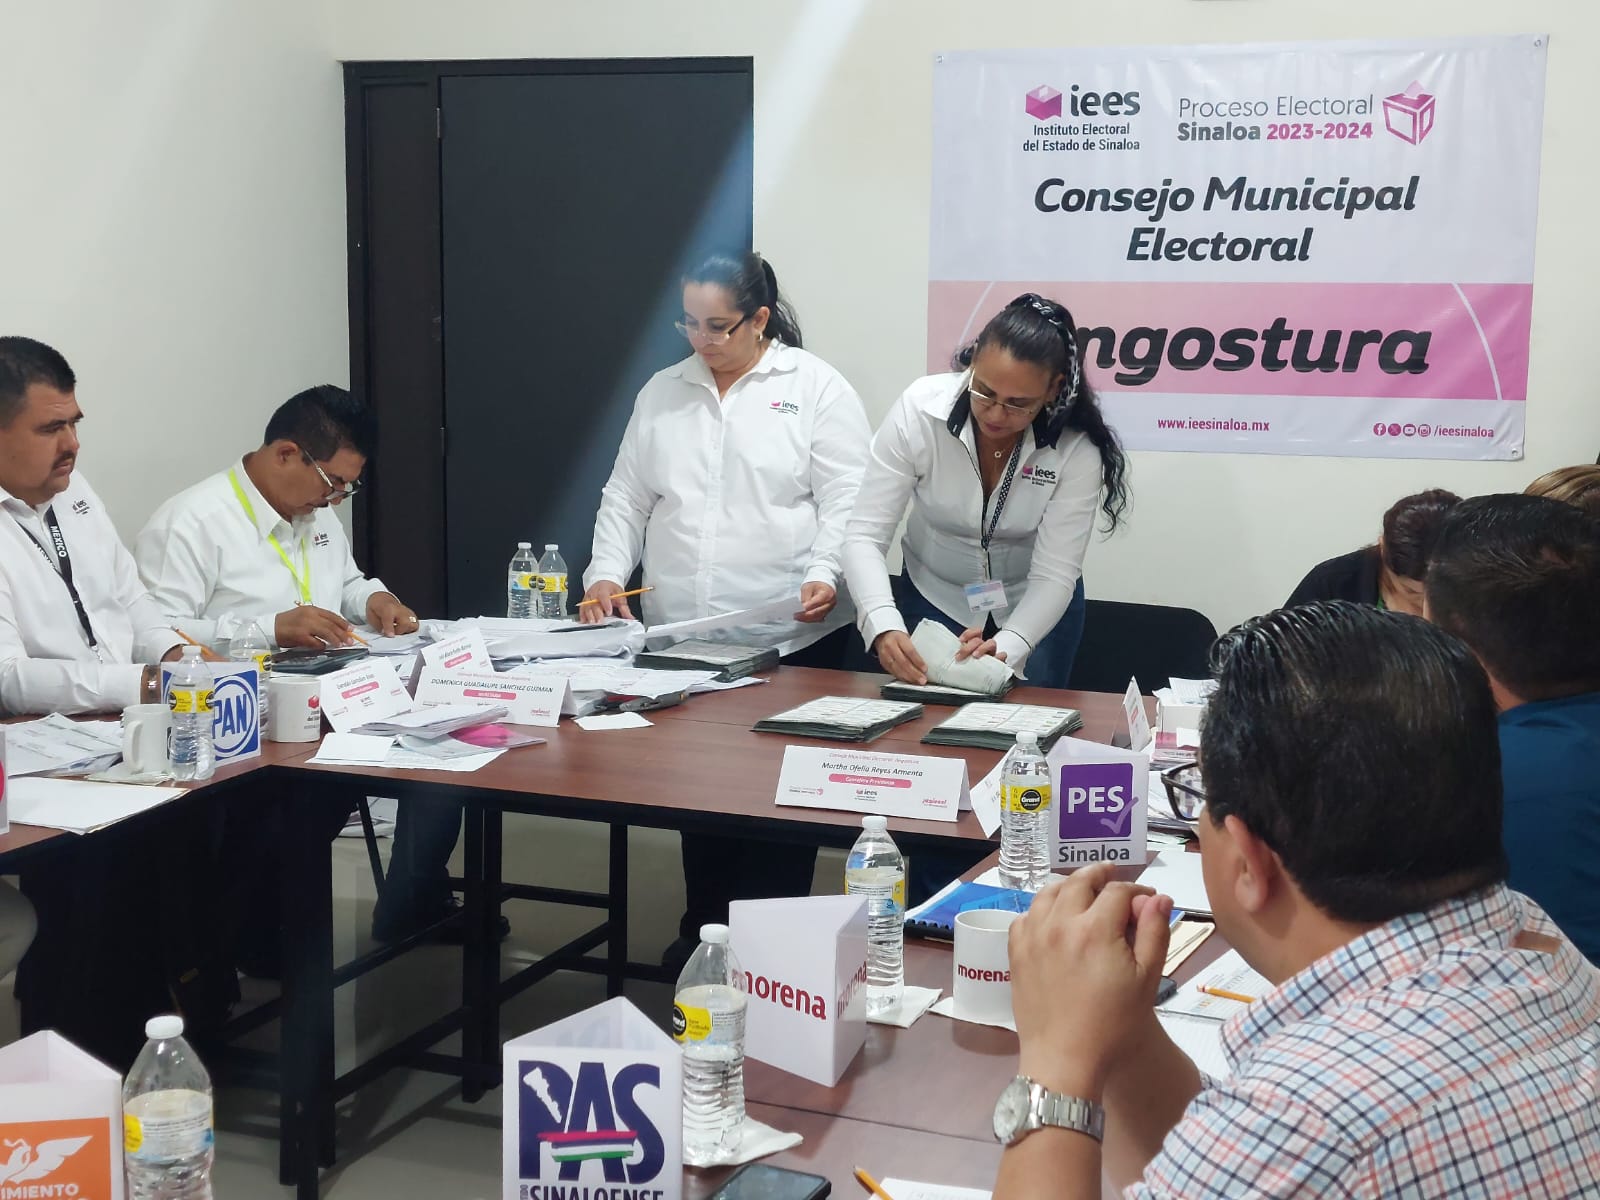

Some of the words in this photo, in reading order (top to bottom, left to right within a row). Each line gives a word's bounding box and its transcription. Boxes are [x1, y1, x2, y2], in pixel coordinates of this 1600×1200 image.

[1070, 84, 1141, 117] iees
[1179, 97, 1269, 118] Proceso
[1276, 94, 1374, 116] Electoral
[1033, 124, 1079, 136] Instituto
[1082, 122, 1130, 135] Electoral
[1177, 121, 1261, 141] Sinaloa
[1266, 122, 1374, 140] 2023-2024
[1023, 140, 1040, 151] del
[1042, 139, 1080, 151] Estado
[1082, 139, 1096, 150] de
[1099, 138, 1140, 150] Sinaloa
[1034, 177, 1195, 223] Consejo
[1202, 175, 1420, 219] Municipal
[1126, 227, 1314, 261] Electoral
[1077, 317, 1433, 387] ngostura
[1157, 417, 1270, 432] www.ieesinaloa.mx
[1433, 424, 1495, 439] /ieesinaloa
[1034, 464, 1056, 480] iees
[50, 525, 67, 558] MEXICO
[212, 693, 247, 740] PAN
[821, 762, 848, 770] Martha
[849, 764, 869, 773] Ofelia
[871, 766, 891, 775] Reyes
[892, 768, 924, 777] Armenta
[1067, 785, 1125, 814] PES
[1058, 844, 1130, 863] Sinaloa
[957, 963, 1012, 982] morena
[732, 967, 827, 1020] morena
[518, 1059, 665, 1185] PAS
[0, 1183, 79, 1200] IMIENTO
